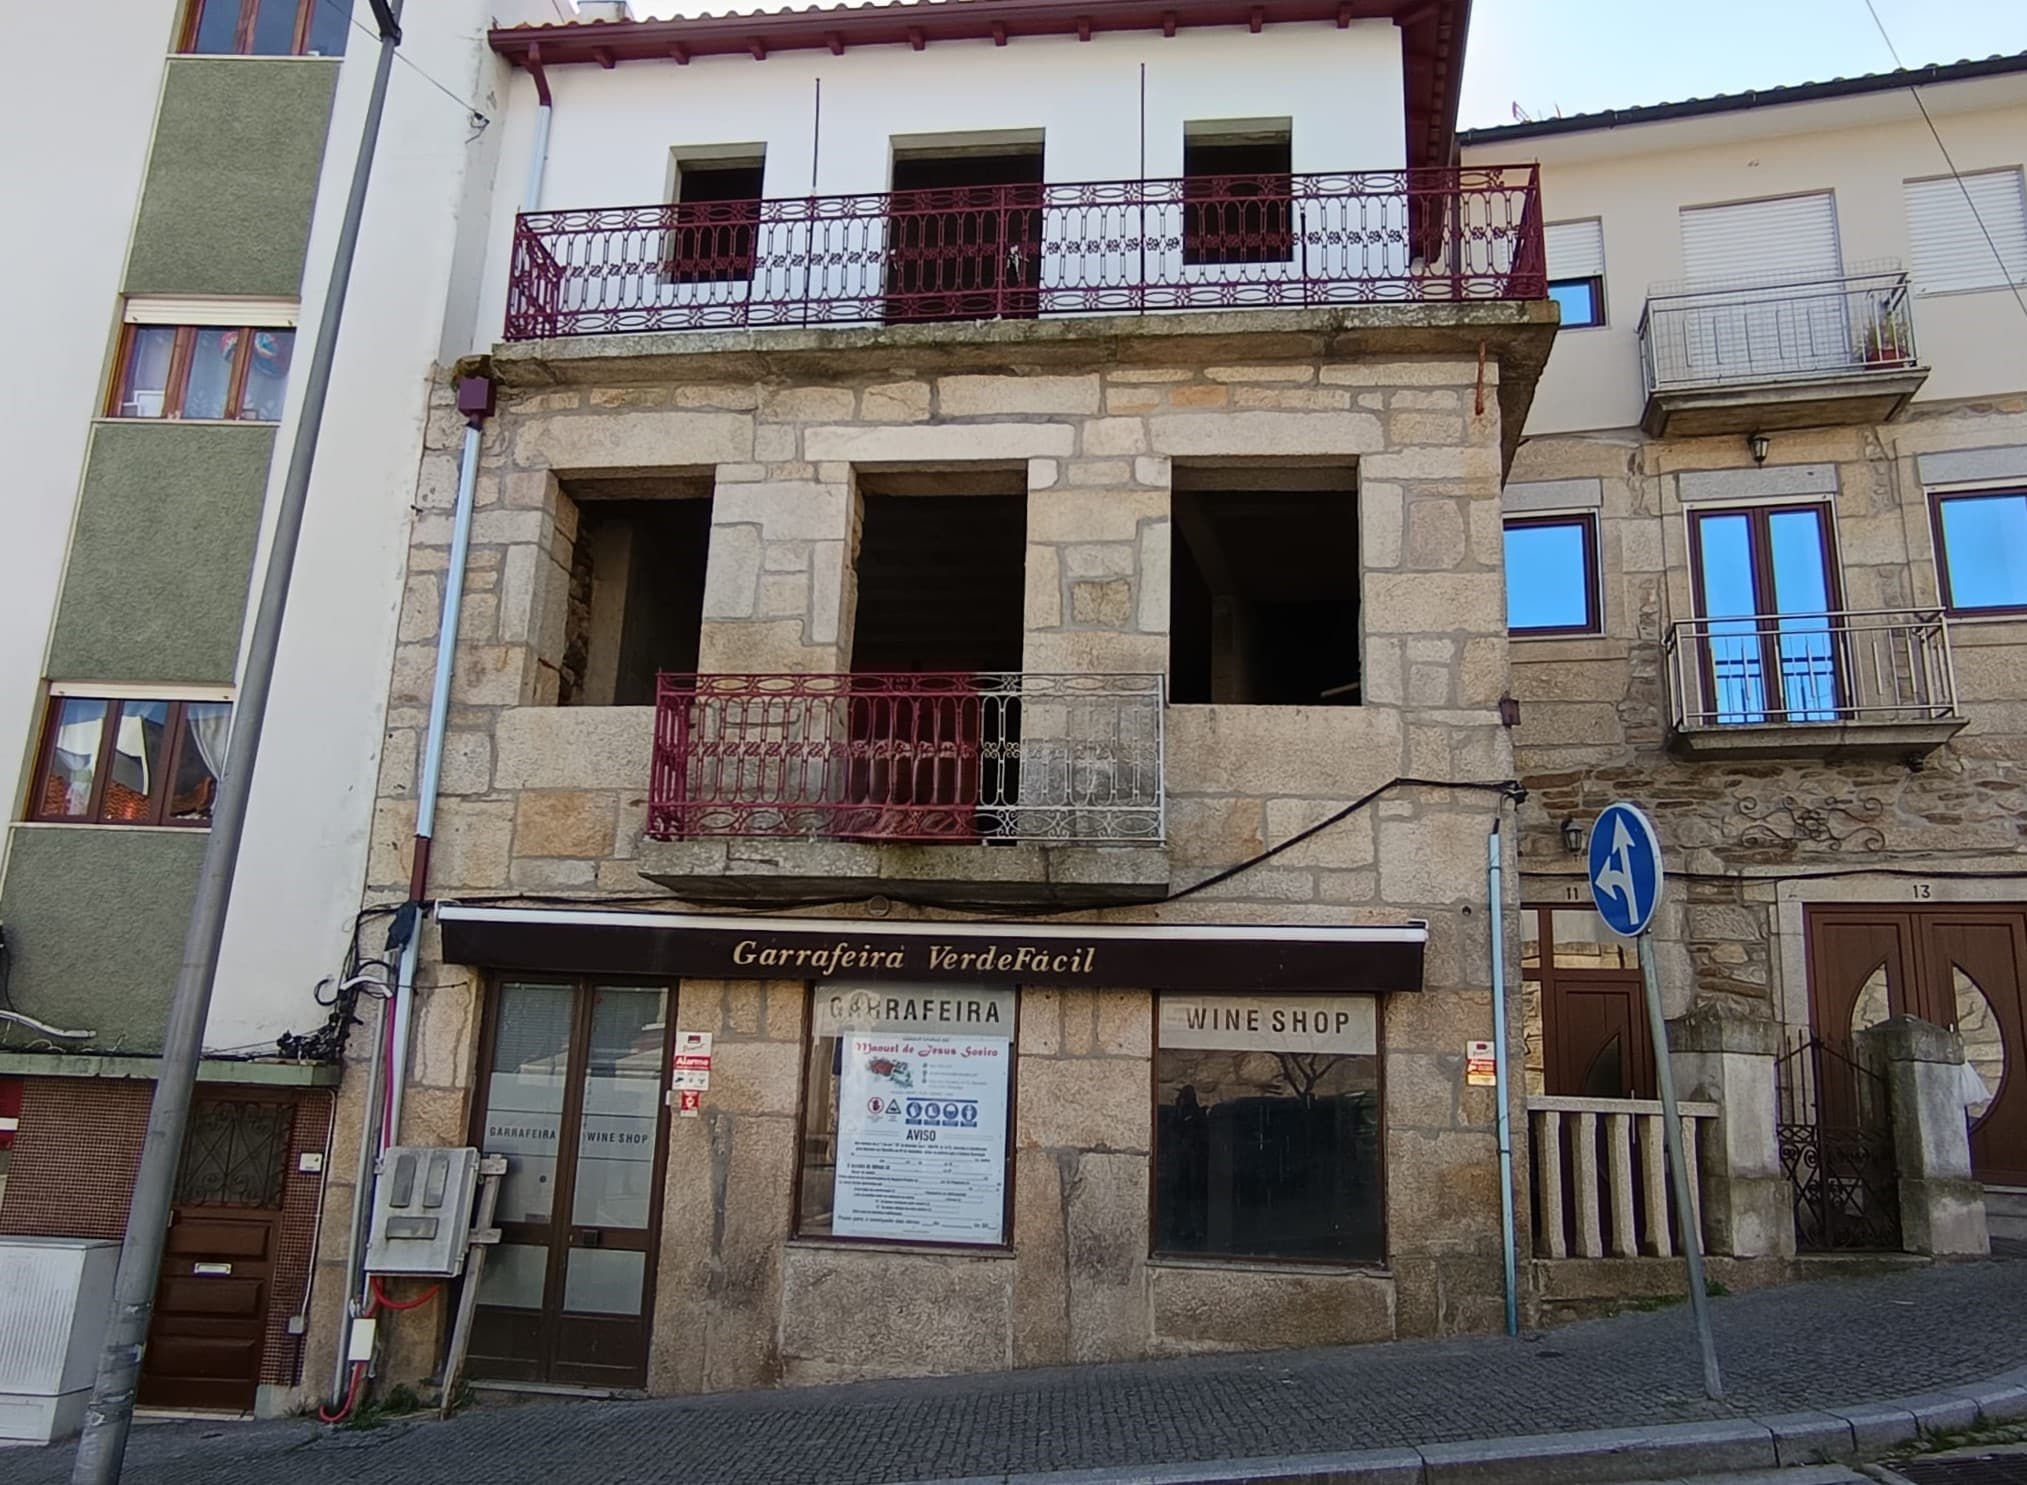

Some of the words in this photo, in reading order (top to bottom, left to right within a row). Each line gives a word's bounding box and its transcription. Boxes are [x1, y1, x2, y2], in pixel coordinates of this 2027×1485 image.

[1566, 887, 1579, 900] 11
[1913, 884, 1931, 899] 13
[928, 945, 1096, 974] VerdeFácil
[1186, 1007, 1259, 1031] WINE
[1271, 1009, 1349, 1034] SHOP
[856, 1041, 899, 1055] Manuel
[902, 1043, 915, 1054] de
[918, 1044, 957, 1057] Jesus
[489, 1126, 556, 1140] GARRAFEIRA
[587, 1131, 615, 1143] WINE
[618, 1132, 649, 1144] SHOP
[905, 1129, 936, 1142] AVISO
